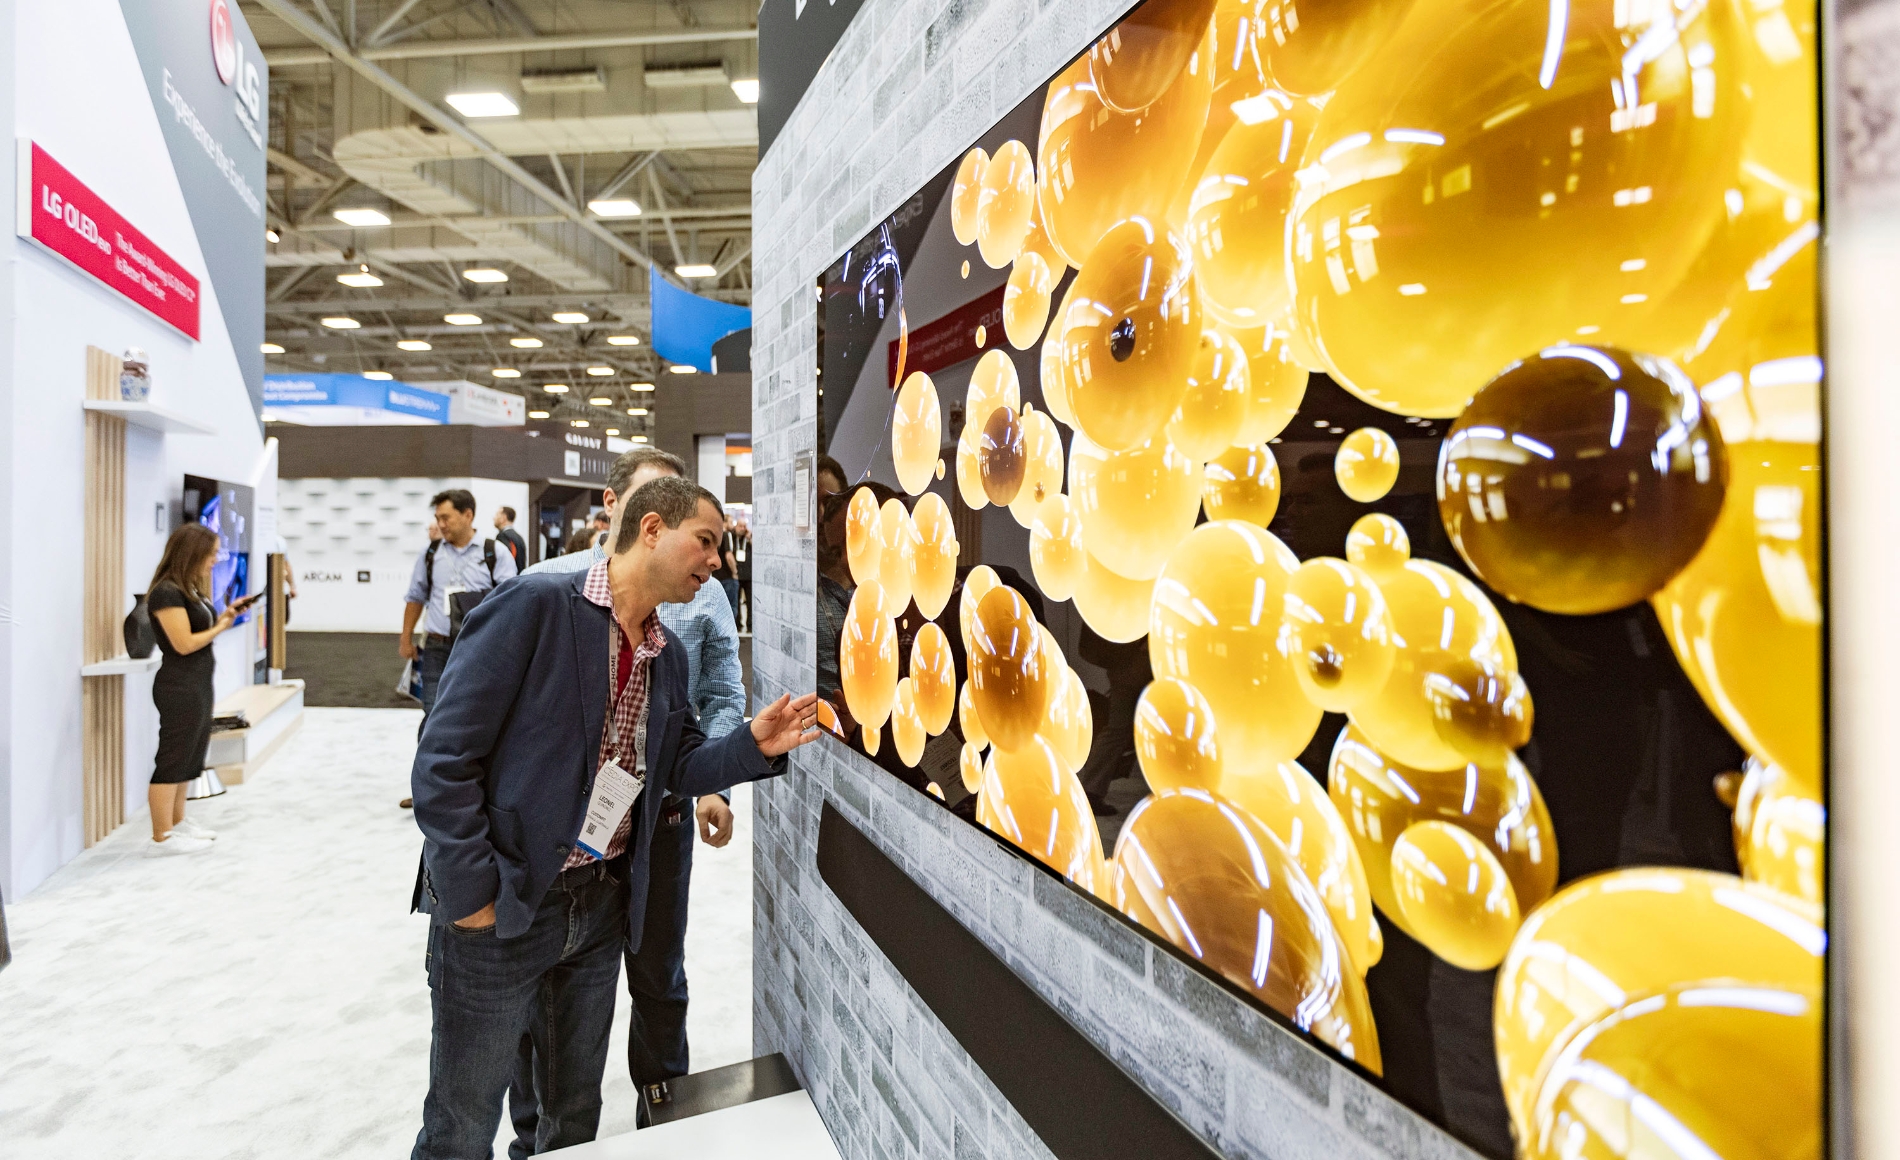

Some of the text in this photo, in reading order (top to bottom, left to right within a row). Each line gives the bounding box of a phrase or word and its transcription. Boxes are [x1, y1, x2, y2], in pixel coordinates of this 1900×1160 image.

[236, 41, 260, 121] LG
[163, 66, 216, 160] Experience
[42, 184, 62, 219] LG
[64, 202, 98, 244] OLED
[303, 571, 342, 582] ARCAM
[637, 710, 649, 751] CRESTRON
[603, 766, 622, 783] CEDIA
[621, 778, 639, 794] EXPO
[598, 794, 615, 809] LEONEL
